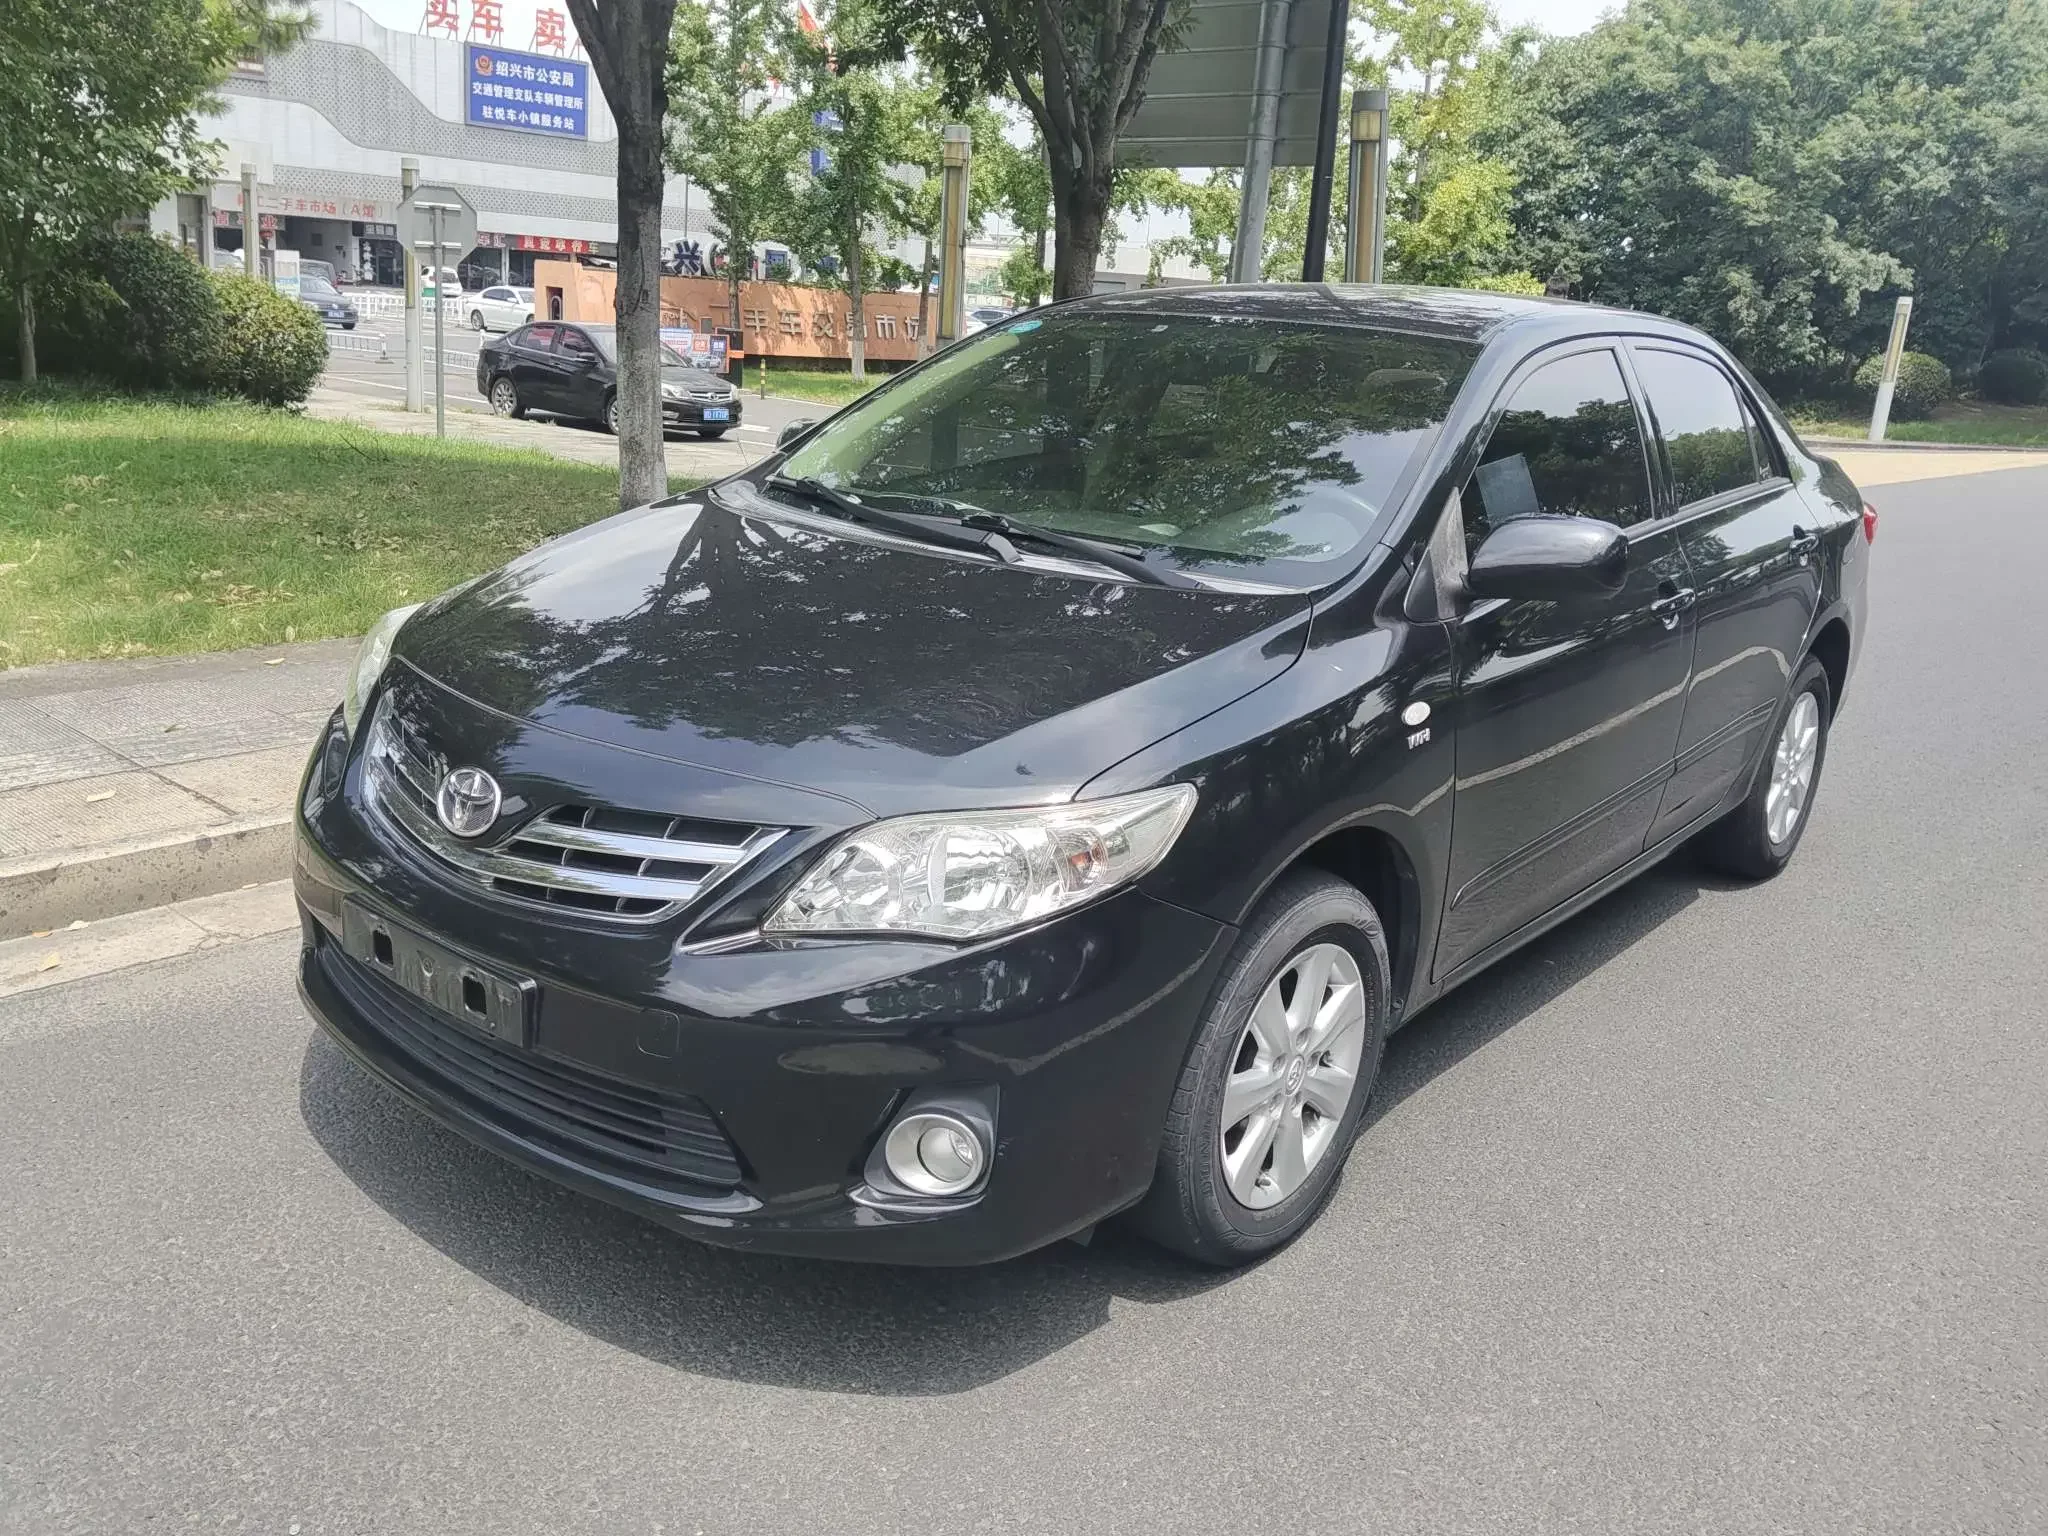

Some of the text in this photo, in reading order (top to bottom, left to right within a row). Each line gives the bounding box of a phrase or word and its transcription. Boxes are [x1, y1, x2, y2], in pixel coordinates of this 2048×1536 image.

[495, 60, 575, 88] 绍兴市公安局
[472, 82, 583, 110] 交通管理支队车辆管理所
[482, 105, 574, 130] 驻悦车小镇服务站
